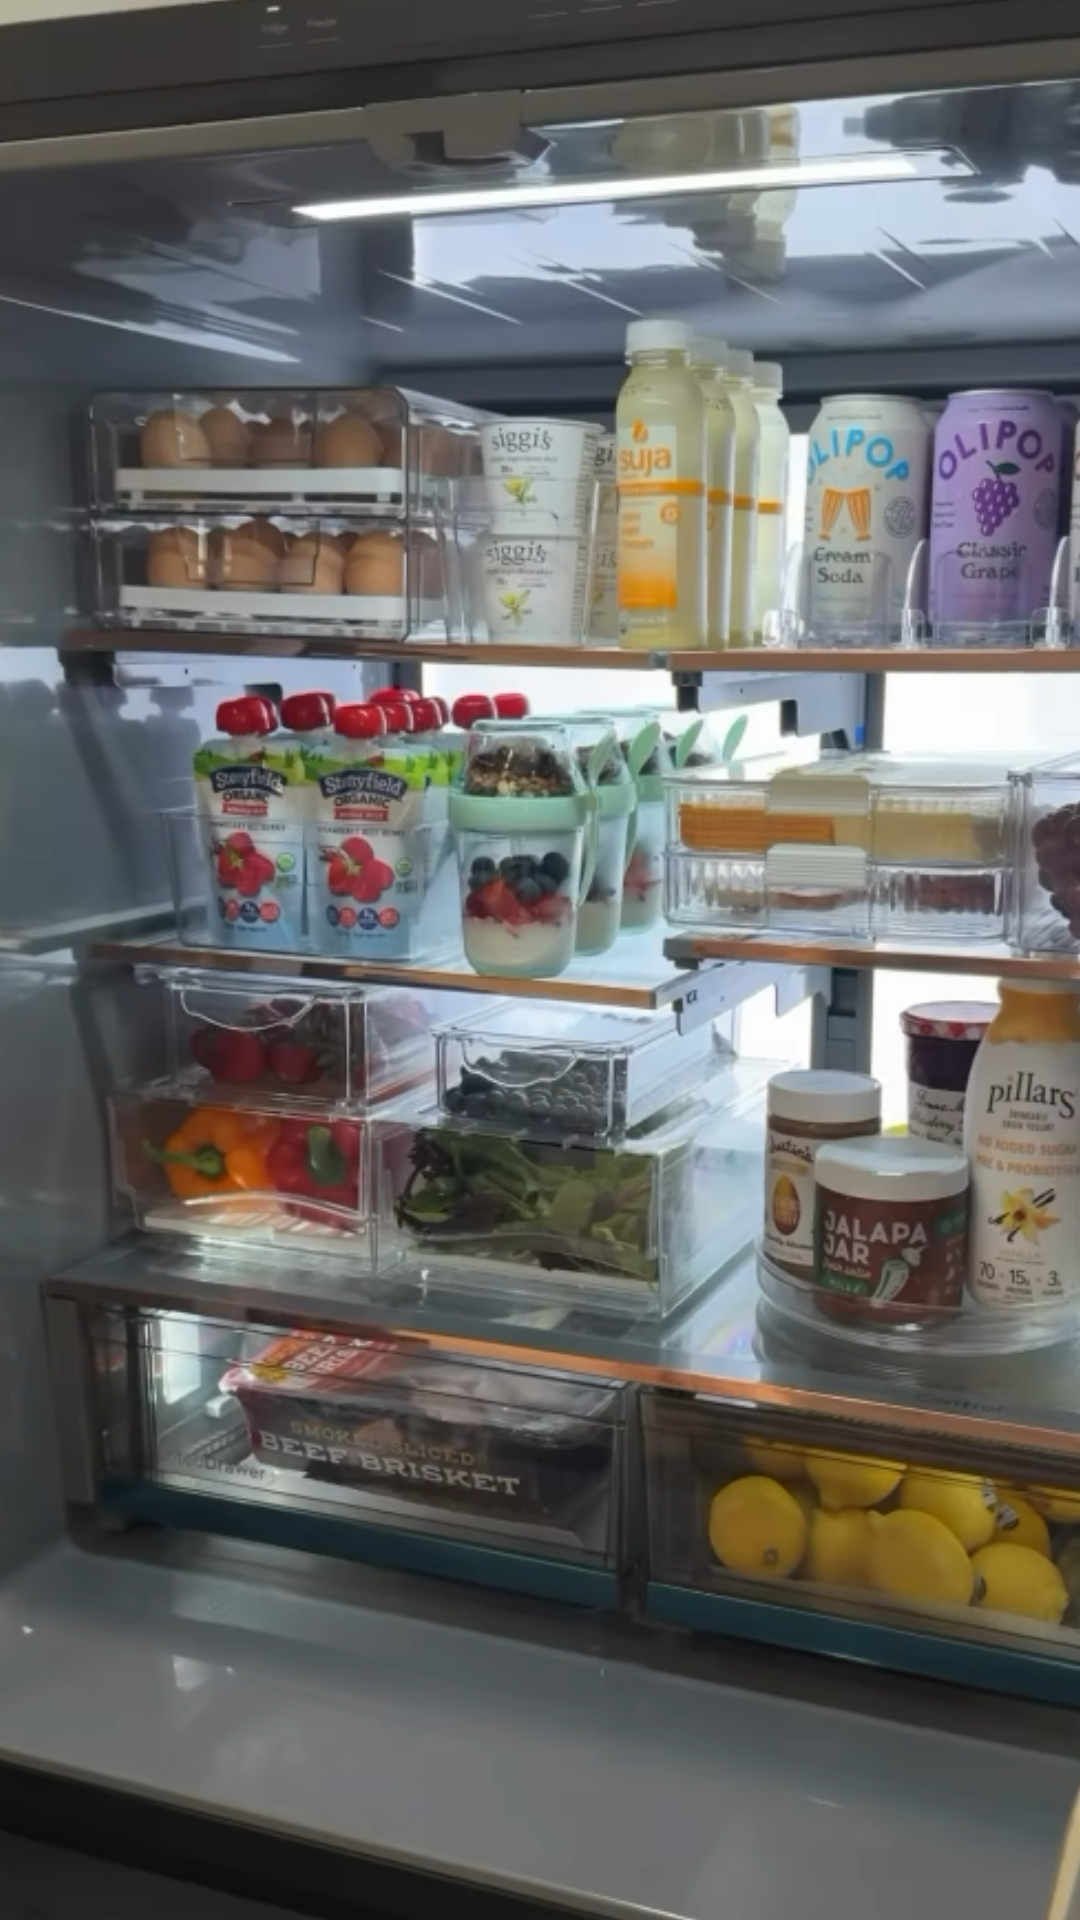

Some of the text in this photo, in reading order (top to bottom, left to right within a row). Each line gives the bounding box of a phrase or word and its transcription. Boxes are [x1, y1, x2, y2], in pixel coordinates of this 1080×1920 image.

[620, 446, 672, 477] suja
[939, 420, 1055, 481] OLIPOP
[814, 546, 872, 564] Cream
[956, 541, 1028, 559] Classic
[817, 567, 864, 584] Soda
[961, 562, 1020, 582] Grape
[324, 772, 404, 795] Stonyfield
[334, 794, 392, 809] ORGANIC
[986, 1071, 1077, 1119] pillars
[995, 1138, 1036, 1155] ADDED
[824, 1210, 928, 1245] JALAPA
[823, 1234, 870, 1265] JAR
[979, 1260, 995, 1281] 70
[289, 1420, 476, 1467] SMOKED SLICED
[257, 1429, 521, 1496] BEEF BRISKET
